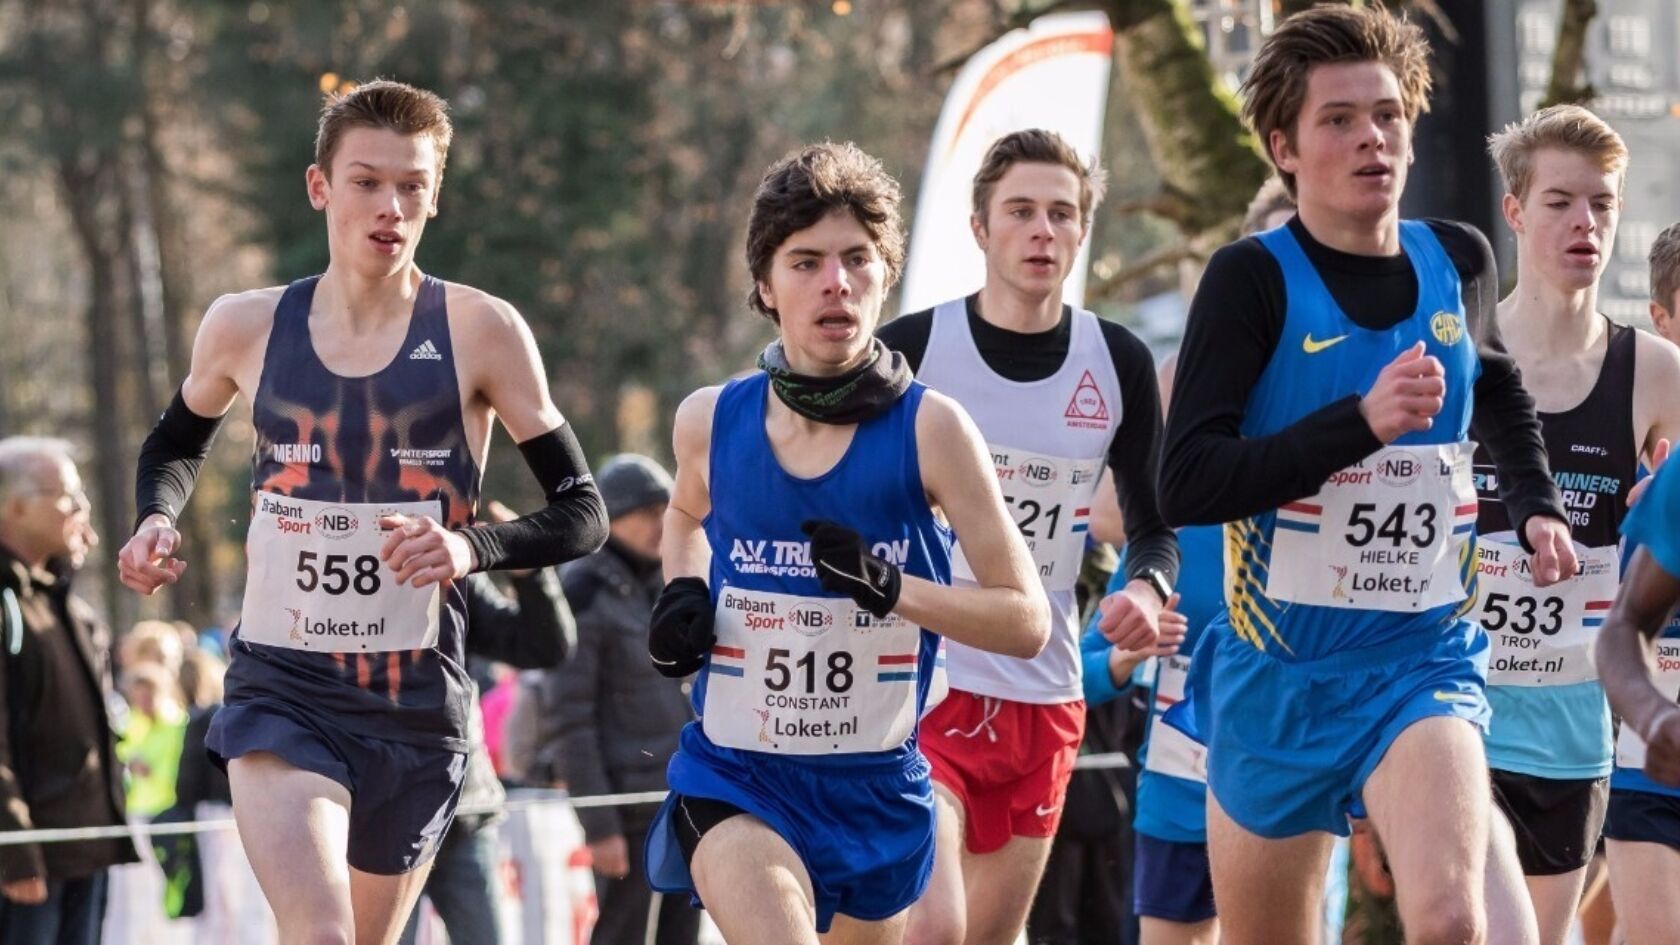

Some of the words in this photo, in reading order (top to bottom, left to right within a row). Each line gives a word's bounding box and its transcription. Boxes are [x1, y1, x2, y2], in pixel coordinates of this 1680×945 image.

[409, 352, 442, 360] adidas
[1066, 421, 1107, 430] AMSTERDAM
[273, 444, 321, 463] MENNO
[400, 449, 452, 458] INTERSPORT
[1571, 444, 1600, 454] CRAFT
[997, 466, 1014, 480] ort
[1026, 463, 1051, 481] NB
[1384, 460, 1414, 477] NB
[1555, 472, 1620, 494] NNERS
[1561, 490, 1597, 508] RLD
[262, 499, 303, 518] Brabant
[277, 517, 311, 534] Sport
[323, 515, 350, 531] NB
[1003, 496, 1062, 540] 21
[1345, 502, 1437, 548] 543
[772, 539, 909, 565] TRION
[1360, 550, 1420, 565] HIELKE
[296, 550, 381, 596] 558
[734, 563, 817, 578] AMERSFOO
[1476, 562, 1507, 578] port
[725, 593, 776, 614] Brabant
[744, 612, 785, 630] Sport
[796, 610, 824, 627] NB
[1480, 593, 1564, 636] 533
[305, 617, 385, 636] Loket.nl
[1500, 634, 1542, 649] TROY
[764, 648, 854, 694] 518
[1488, 655, 1564, 673] oket.nl
[1657, 657, 1680, 672] Spo
[765, 694, 851, 710] CONSTANT
[774, 716, 858, 738] Loket.nl
